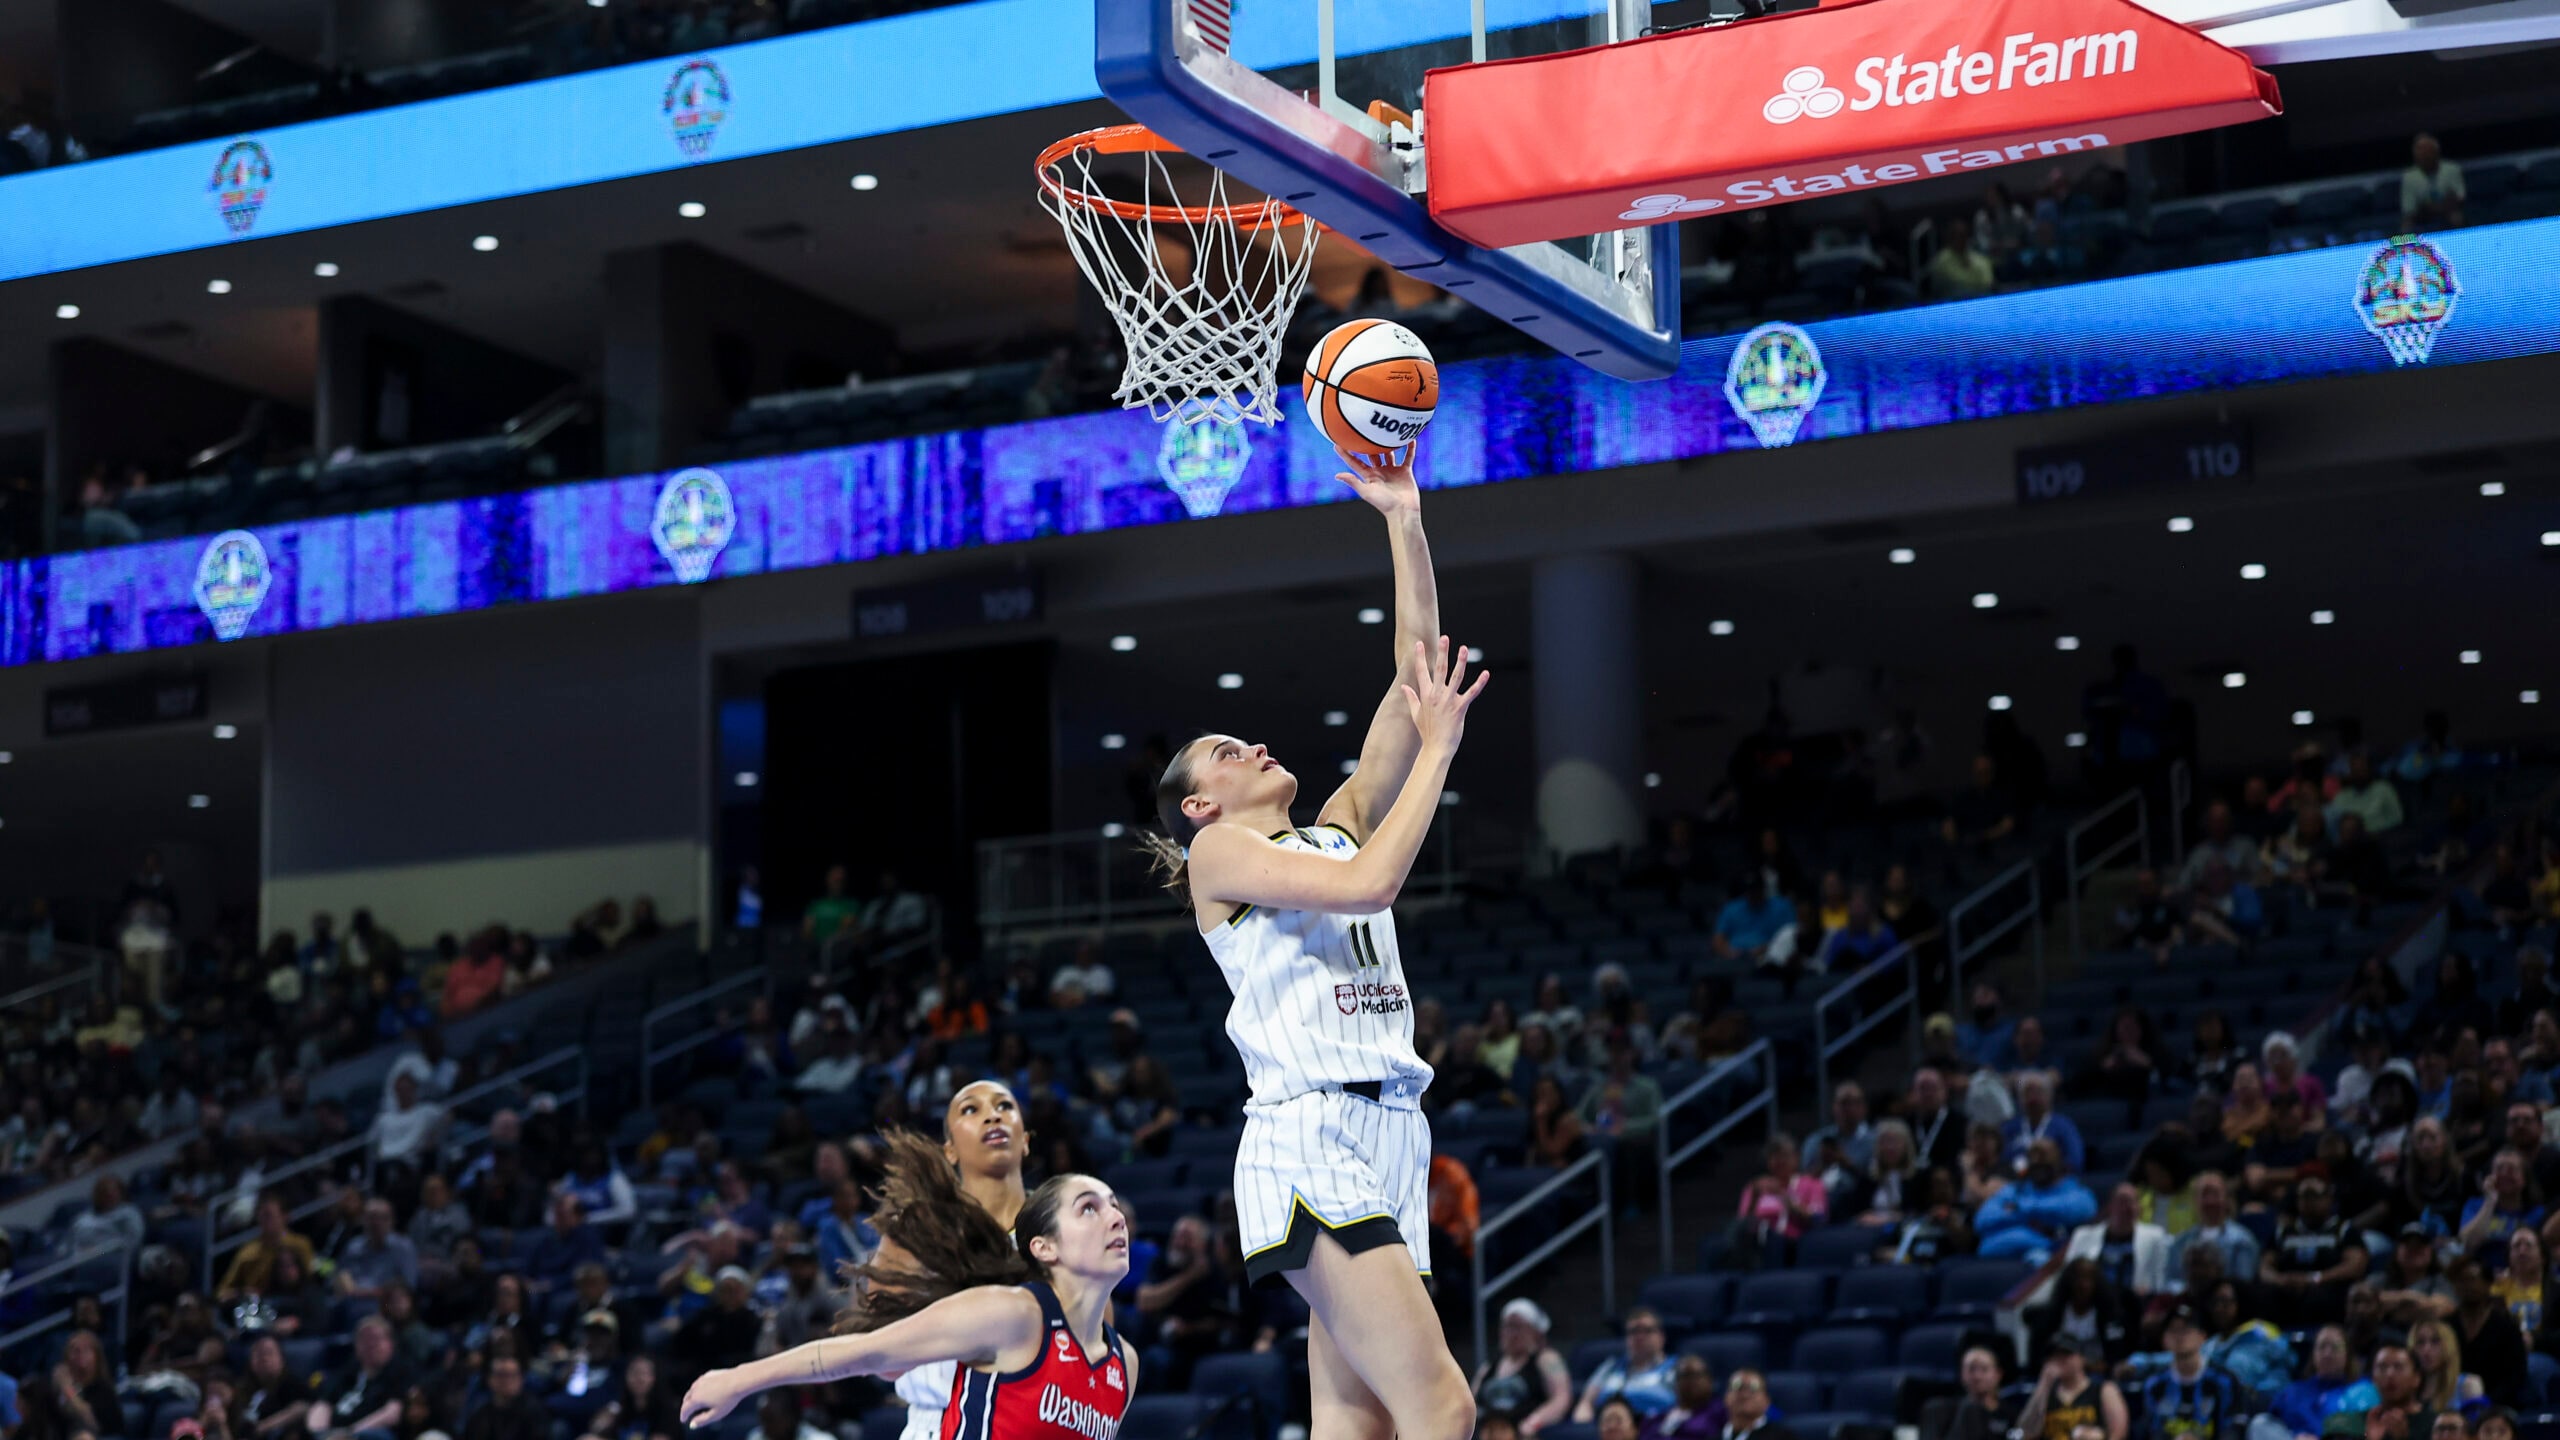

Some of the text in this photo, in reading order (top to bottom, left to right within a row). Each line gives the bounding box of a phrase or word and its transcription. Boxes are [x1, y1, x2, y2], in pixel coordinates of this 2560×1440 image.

[2024, 442, 2241, 497] 109 110
[1347, 920, 1381, 969] 11
[1357, 983, 1406, 998] UChicag
